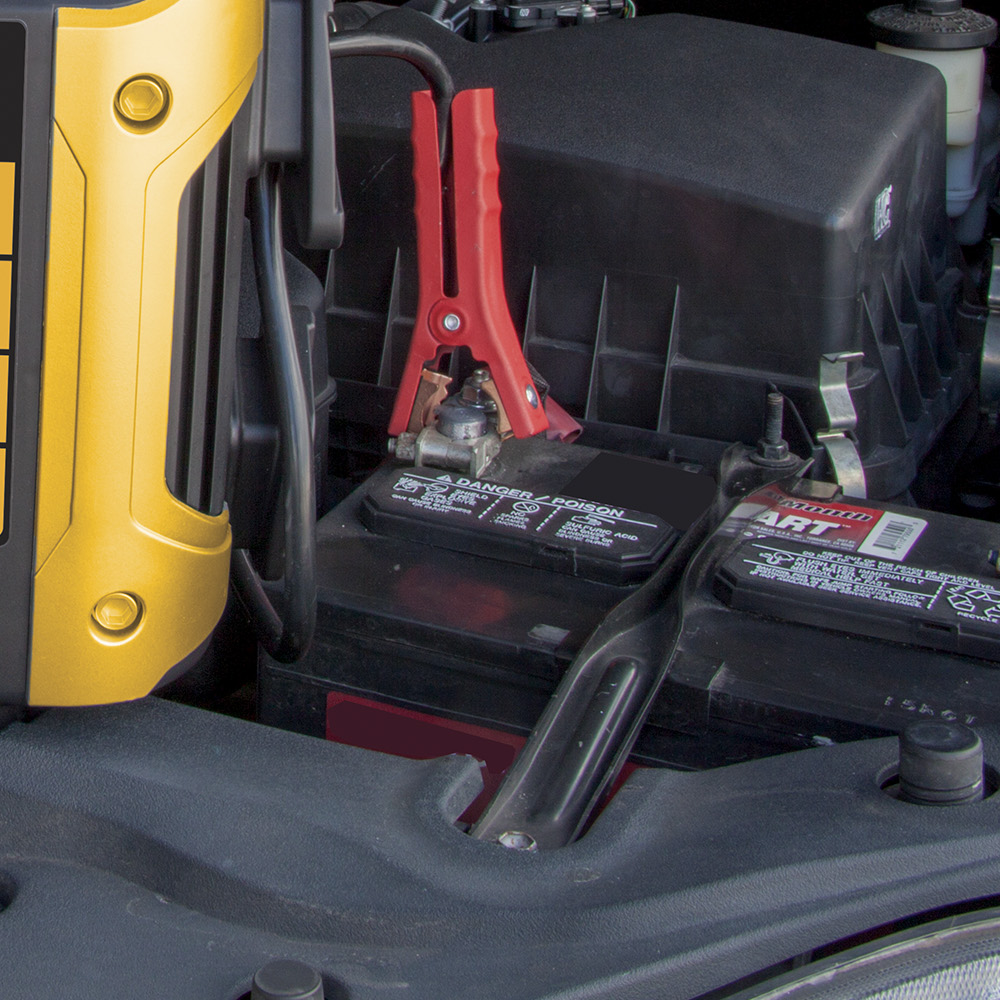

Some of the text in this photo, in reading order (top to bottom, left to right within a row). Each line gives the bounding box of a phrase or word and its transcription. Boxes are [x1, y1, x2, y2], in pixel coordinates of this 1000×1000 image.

[456, 478, 534, 500] DANGER
[551, 497, 625, 517] POISON
[565, 521, 639, 542] SULFURIC ACID
[858, 569, 925, 585] IMMEDIATELY
[957, 611, 999, 624] RECYCLE
